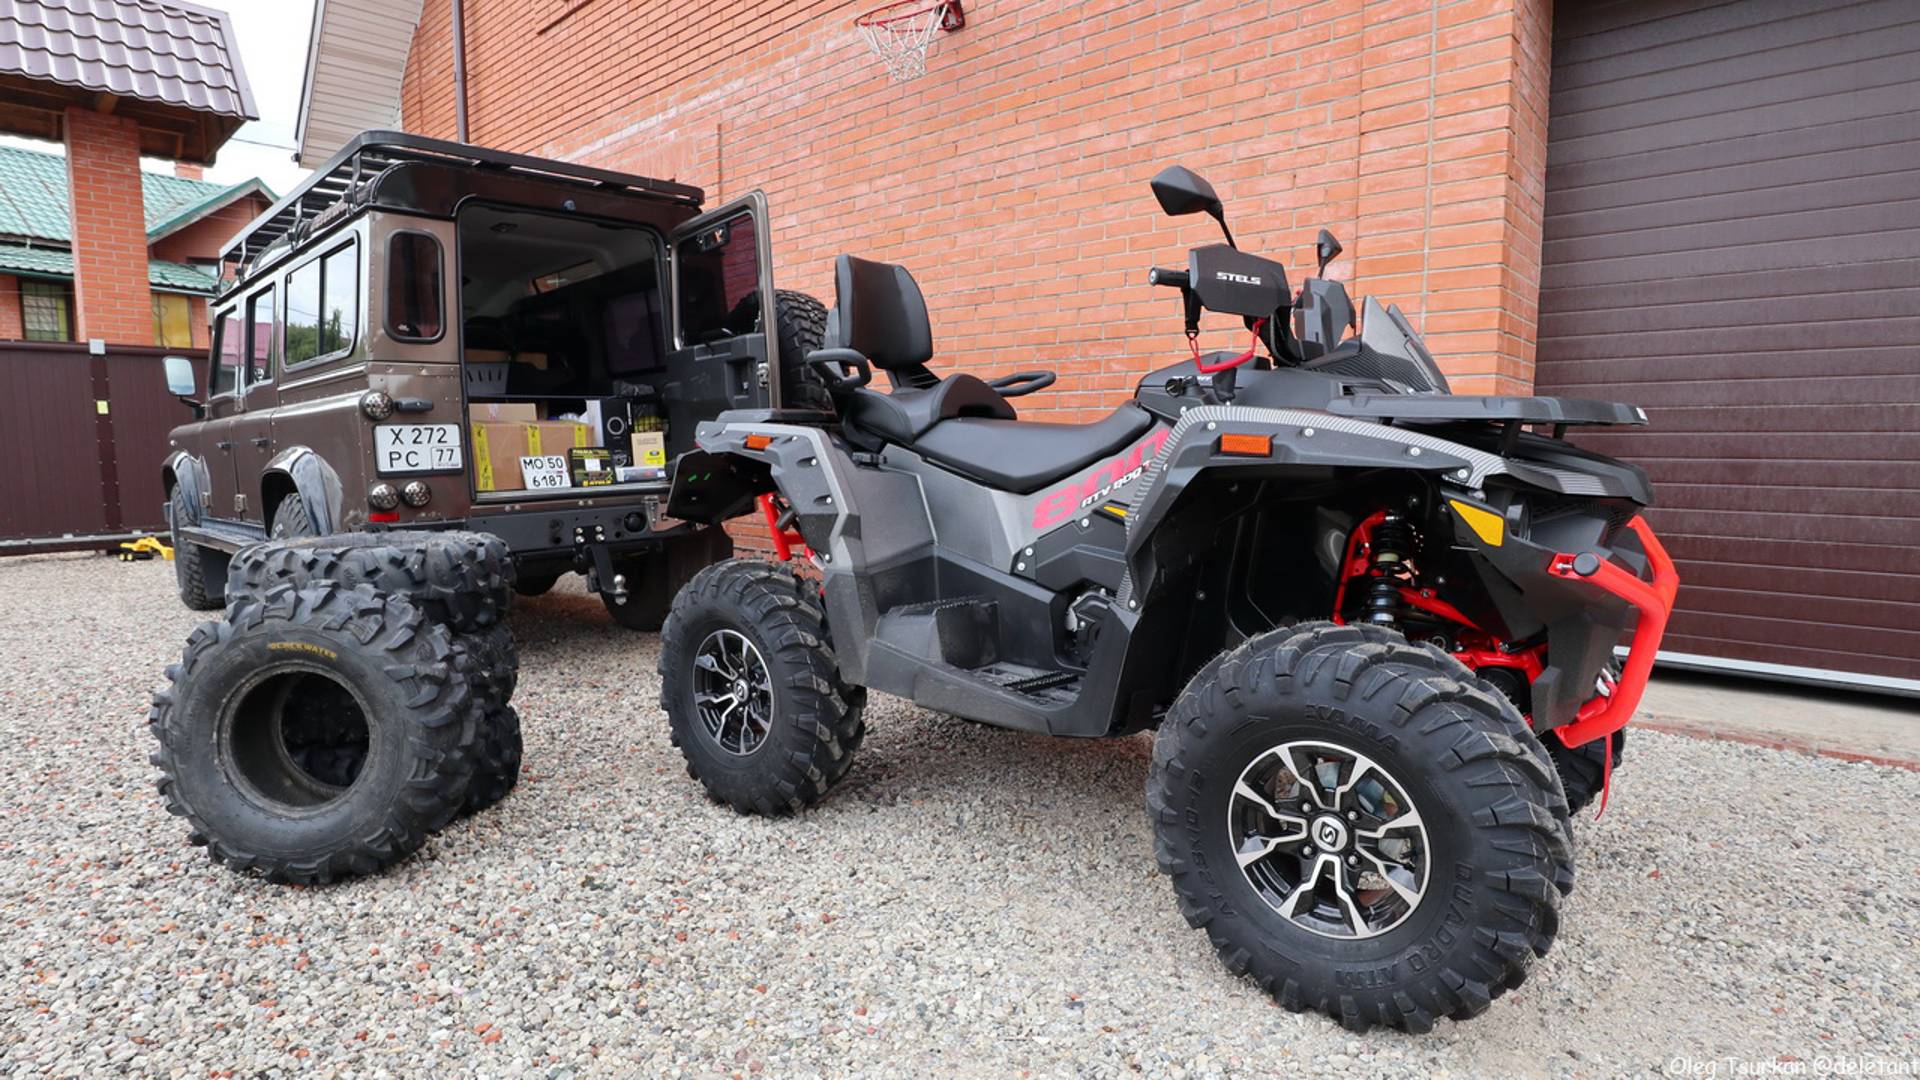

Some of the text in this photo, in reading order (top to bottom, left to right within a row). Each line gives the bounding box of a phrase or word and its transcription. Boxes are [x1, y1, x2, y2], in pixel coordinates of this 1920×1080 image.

[1216, 271, 1262, 286] STELS
[411, 427, 448, 445] 272
[435, 448, 455, 462] 77
[547, 457, 564, 469] 50
[532, 474, 563, 487] 6187
[1081, 485, 1111, 508] ATV
[1113, 465, 1142, 490] 800
